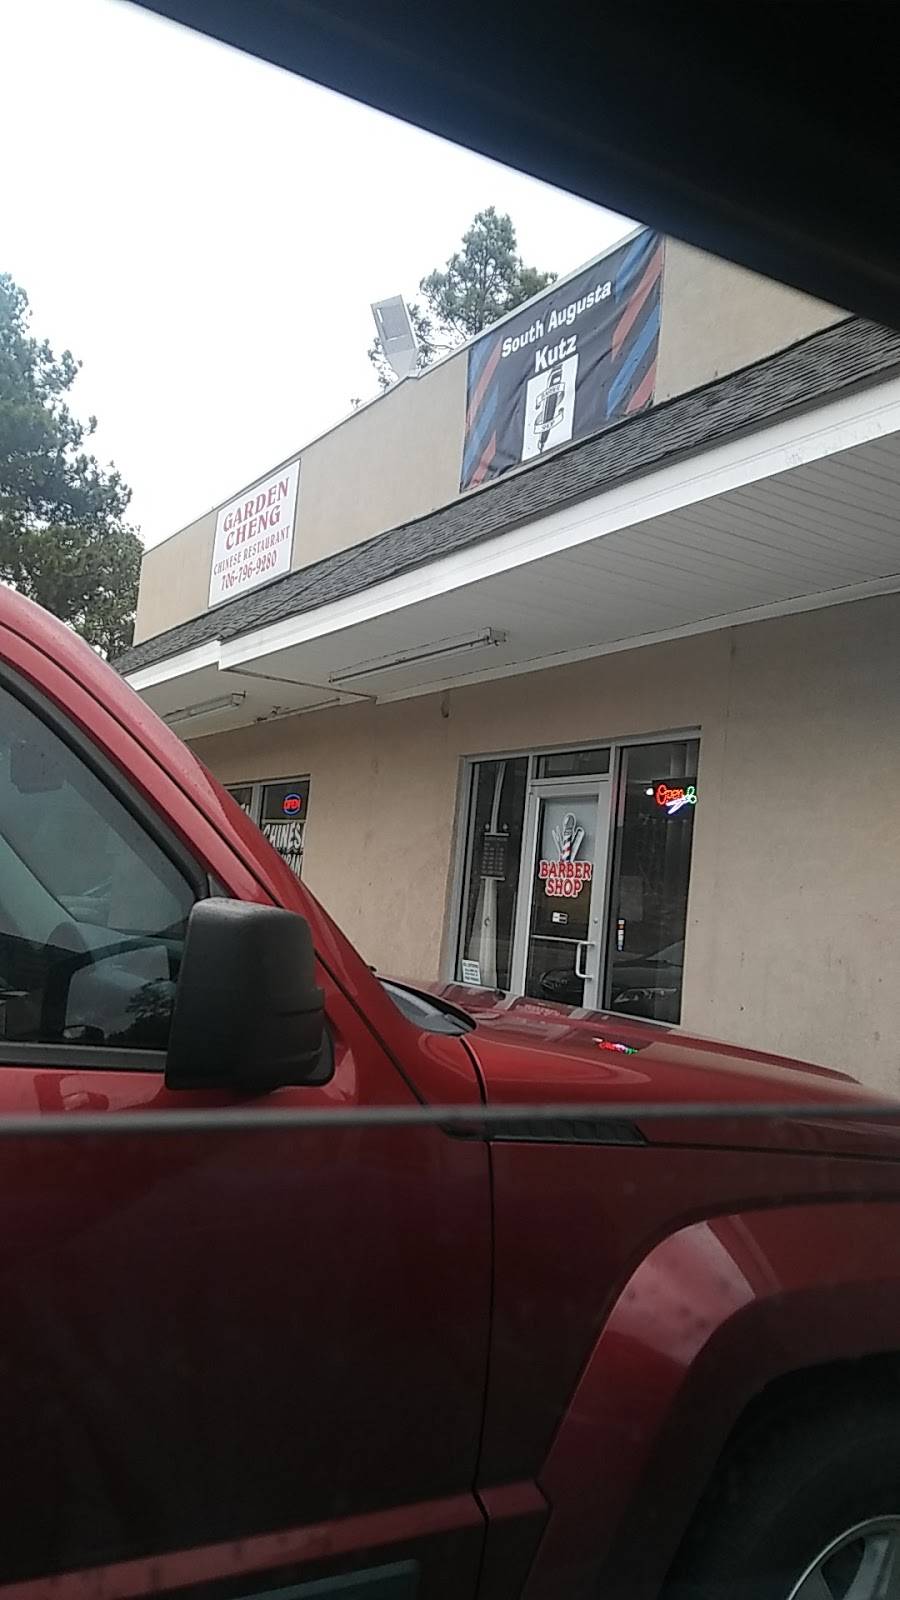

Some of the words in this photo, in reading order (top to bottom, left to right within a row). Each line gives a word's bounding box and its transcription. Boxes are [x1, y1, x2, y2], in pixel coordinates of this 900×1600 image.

[501, 322, 544, 358] South
[548, 281, 612, 332] Augusta
[534, 335, 577, 373] Kutz
[223, 477, 290, 532] GARDEN
[213, 550, 242, 575] CHINESE
[243, 525, 290, 560] RESTAURANT
[225, 505, 281, 550] CHENG
[539, 861, 592, 881] BARBER
[545, 878, 583, 897] SHOP
